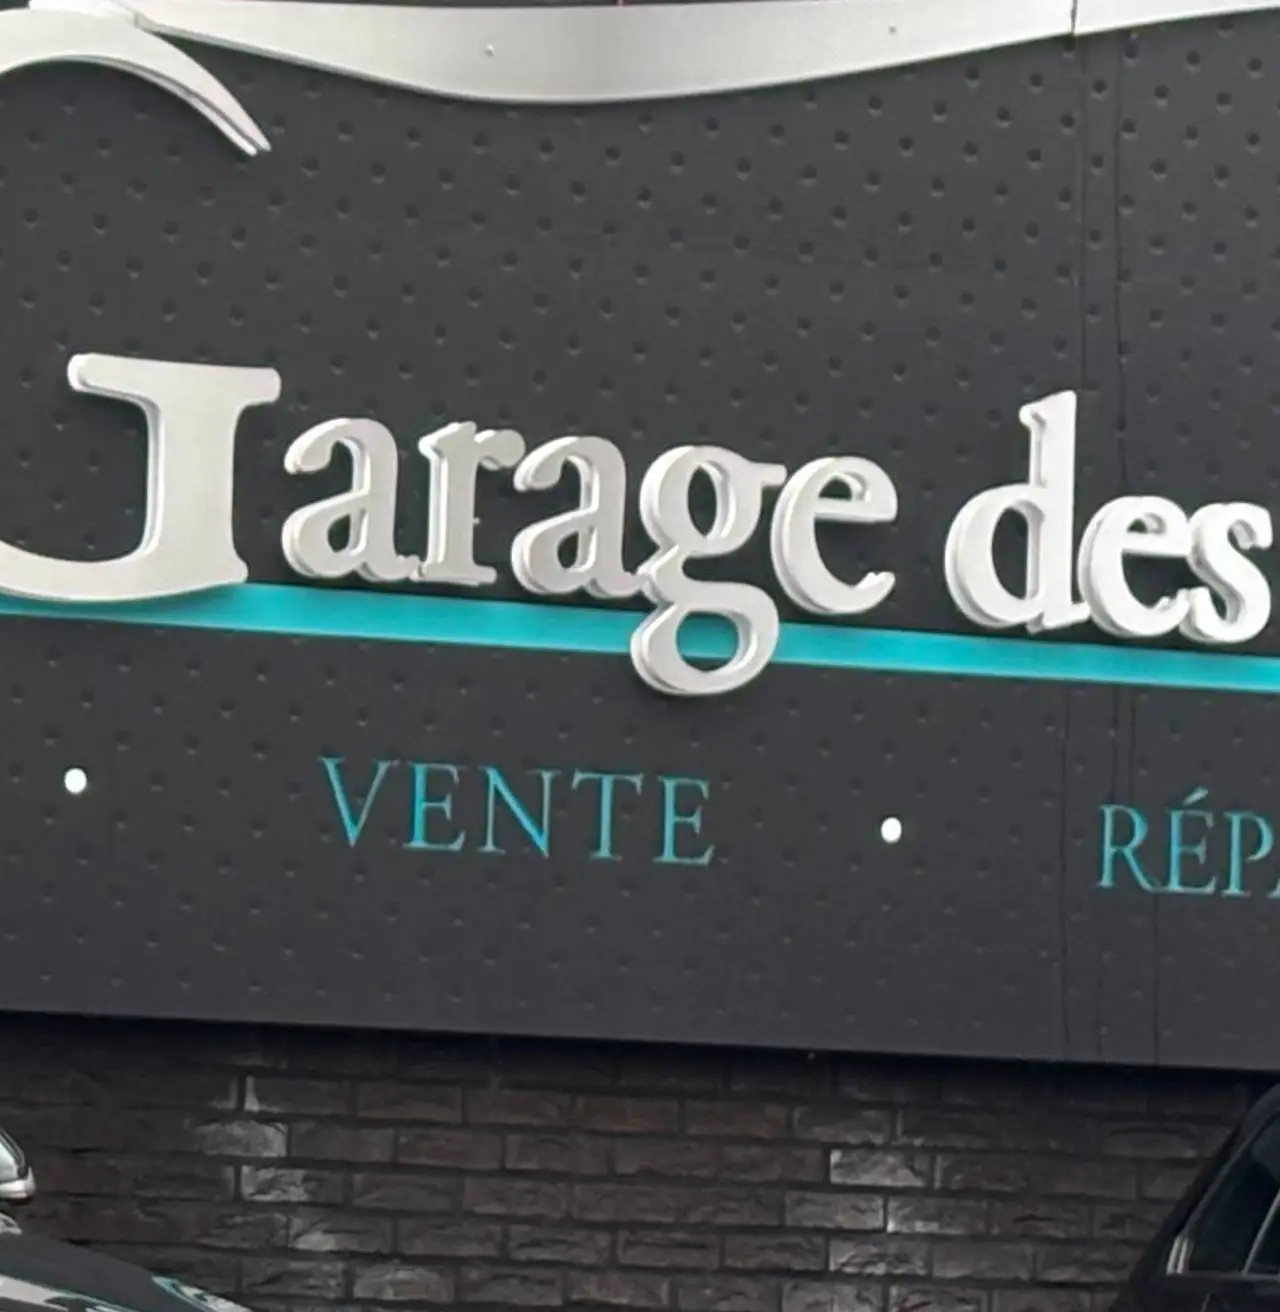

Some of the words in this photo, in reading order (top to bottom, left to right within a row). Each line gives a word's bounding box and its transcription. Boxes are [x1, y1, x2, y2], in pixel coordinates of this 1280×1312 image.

[944, 390, 1272, 642] des
[319, 755, 715, 868] VENTE
[1096, 786, 1280, 898] RÉP
